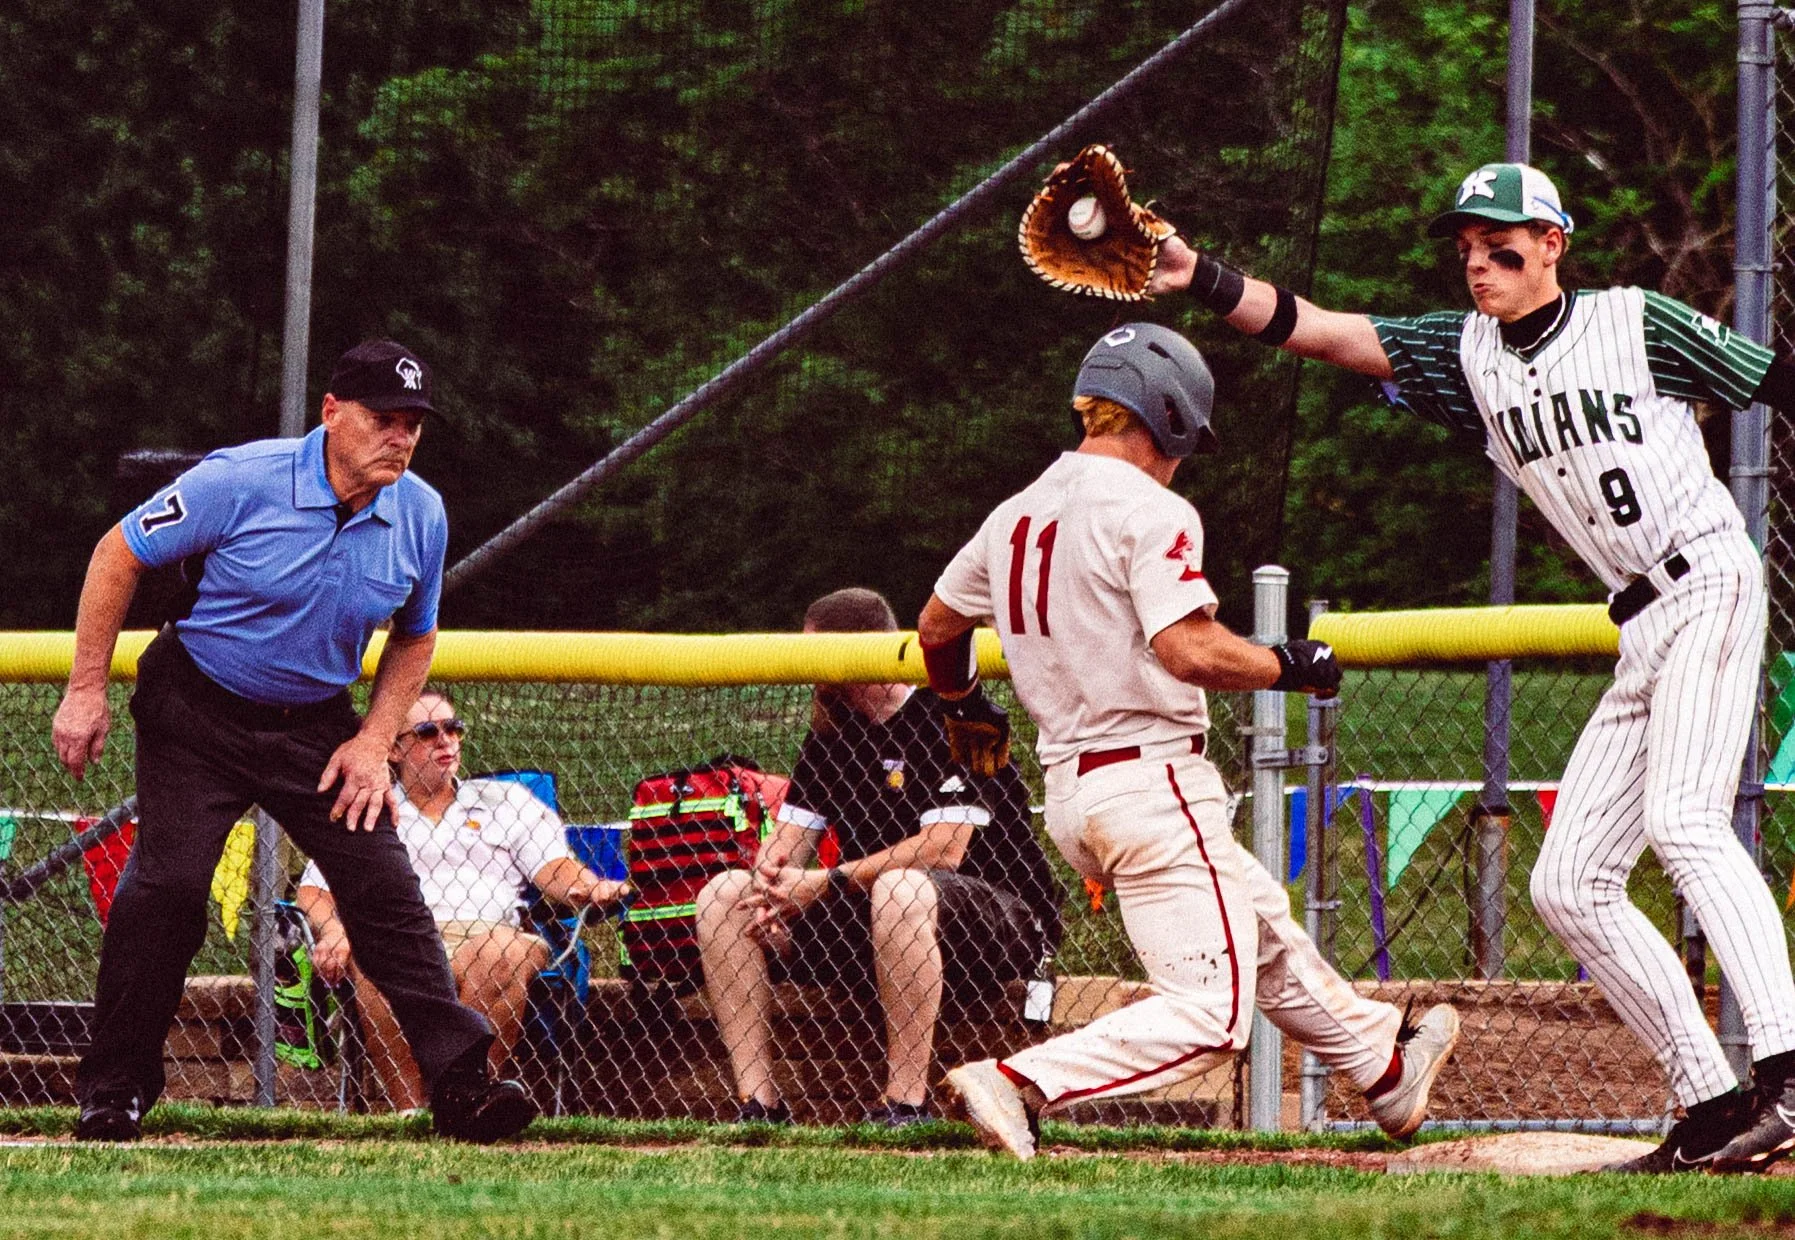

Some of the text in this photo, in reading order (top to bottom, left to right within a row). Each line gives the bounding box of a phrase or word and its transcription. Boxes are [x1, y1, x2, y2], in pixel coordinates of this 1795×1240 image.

[1490, 389, 1643, 475] DIANS
[1599, 467, 1642, 527] 9
[1009, 516, 1058, 637] 11
